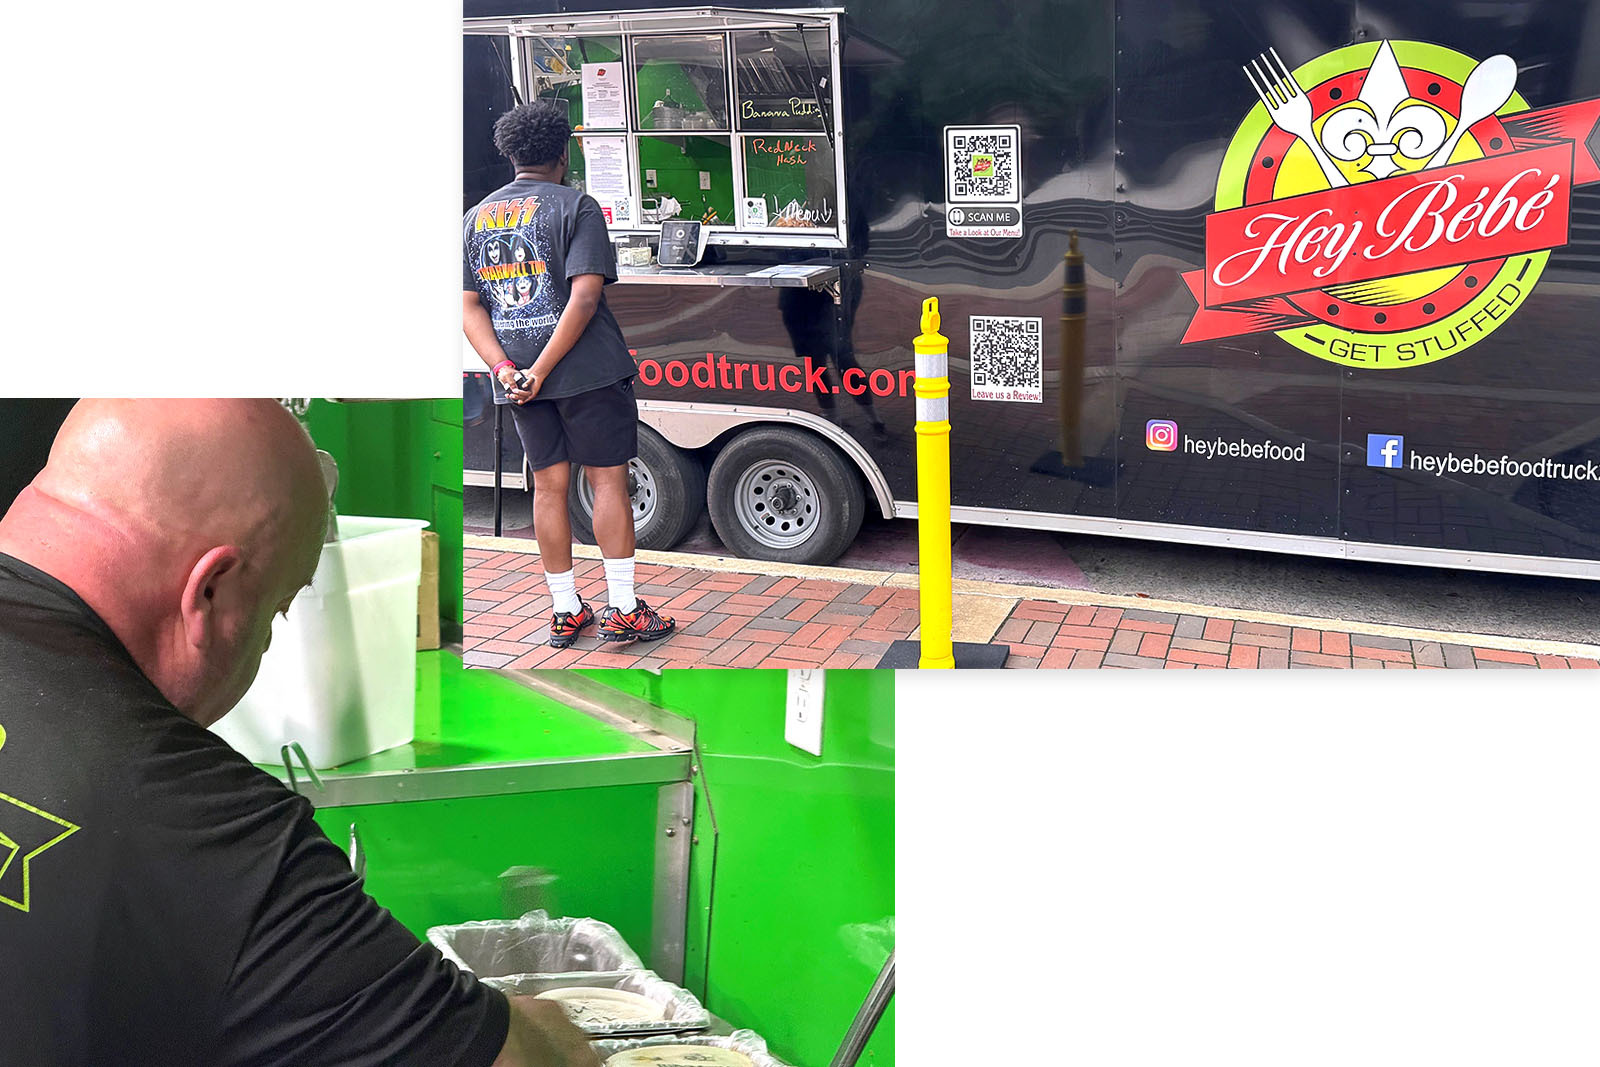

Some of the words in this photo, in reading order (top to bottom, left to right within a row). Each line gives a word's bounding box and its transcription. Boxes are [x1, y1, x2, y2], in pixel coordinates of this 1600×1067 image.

[742, 100, 790, 119] Banana
[788, 96, 822, 118] Puddin
[476, 196, 540, 233] KISS
[968, 213, 994, 222] SCAN
[996, 213, 1011, 222] ME
[1211, 207, 1363, 288] Hey
[1362, 168, 1561, 261] Bébé
[949, 228, 962, 236] Take
[968, 228, 982, 236] Look
[990, 228, 1001, 236] Our
[515, 318, 530, 328] the
[1329, 337, 1387, 362] GET
[1397, 282, 1524, 361] STUFFED
[628, 349, 917, 398] oodtruck.co
[972, 388, 994, 399] Leave
[995, 391, 1005, 400] us
[1006, 392, 1011, 400] a
[1013, 390, 1042, 401] Review!
[1184, 434, 1306, 462] heybebefood
[1410, 450, 1600, 481] heybebefoodtruck
